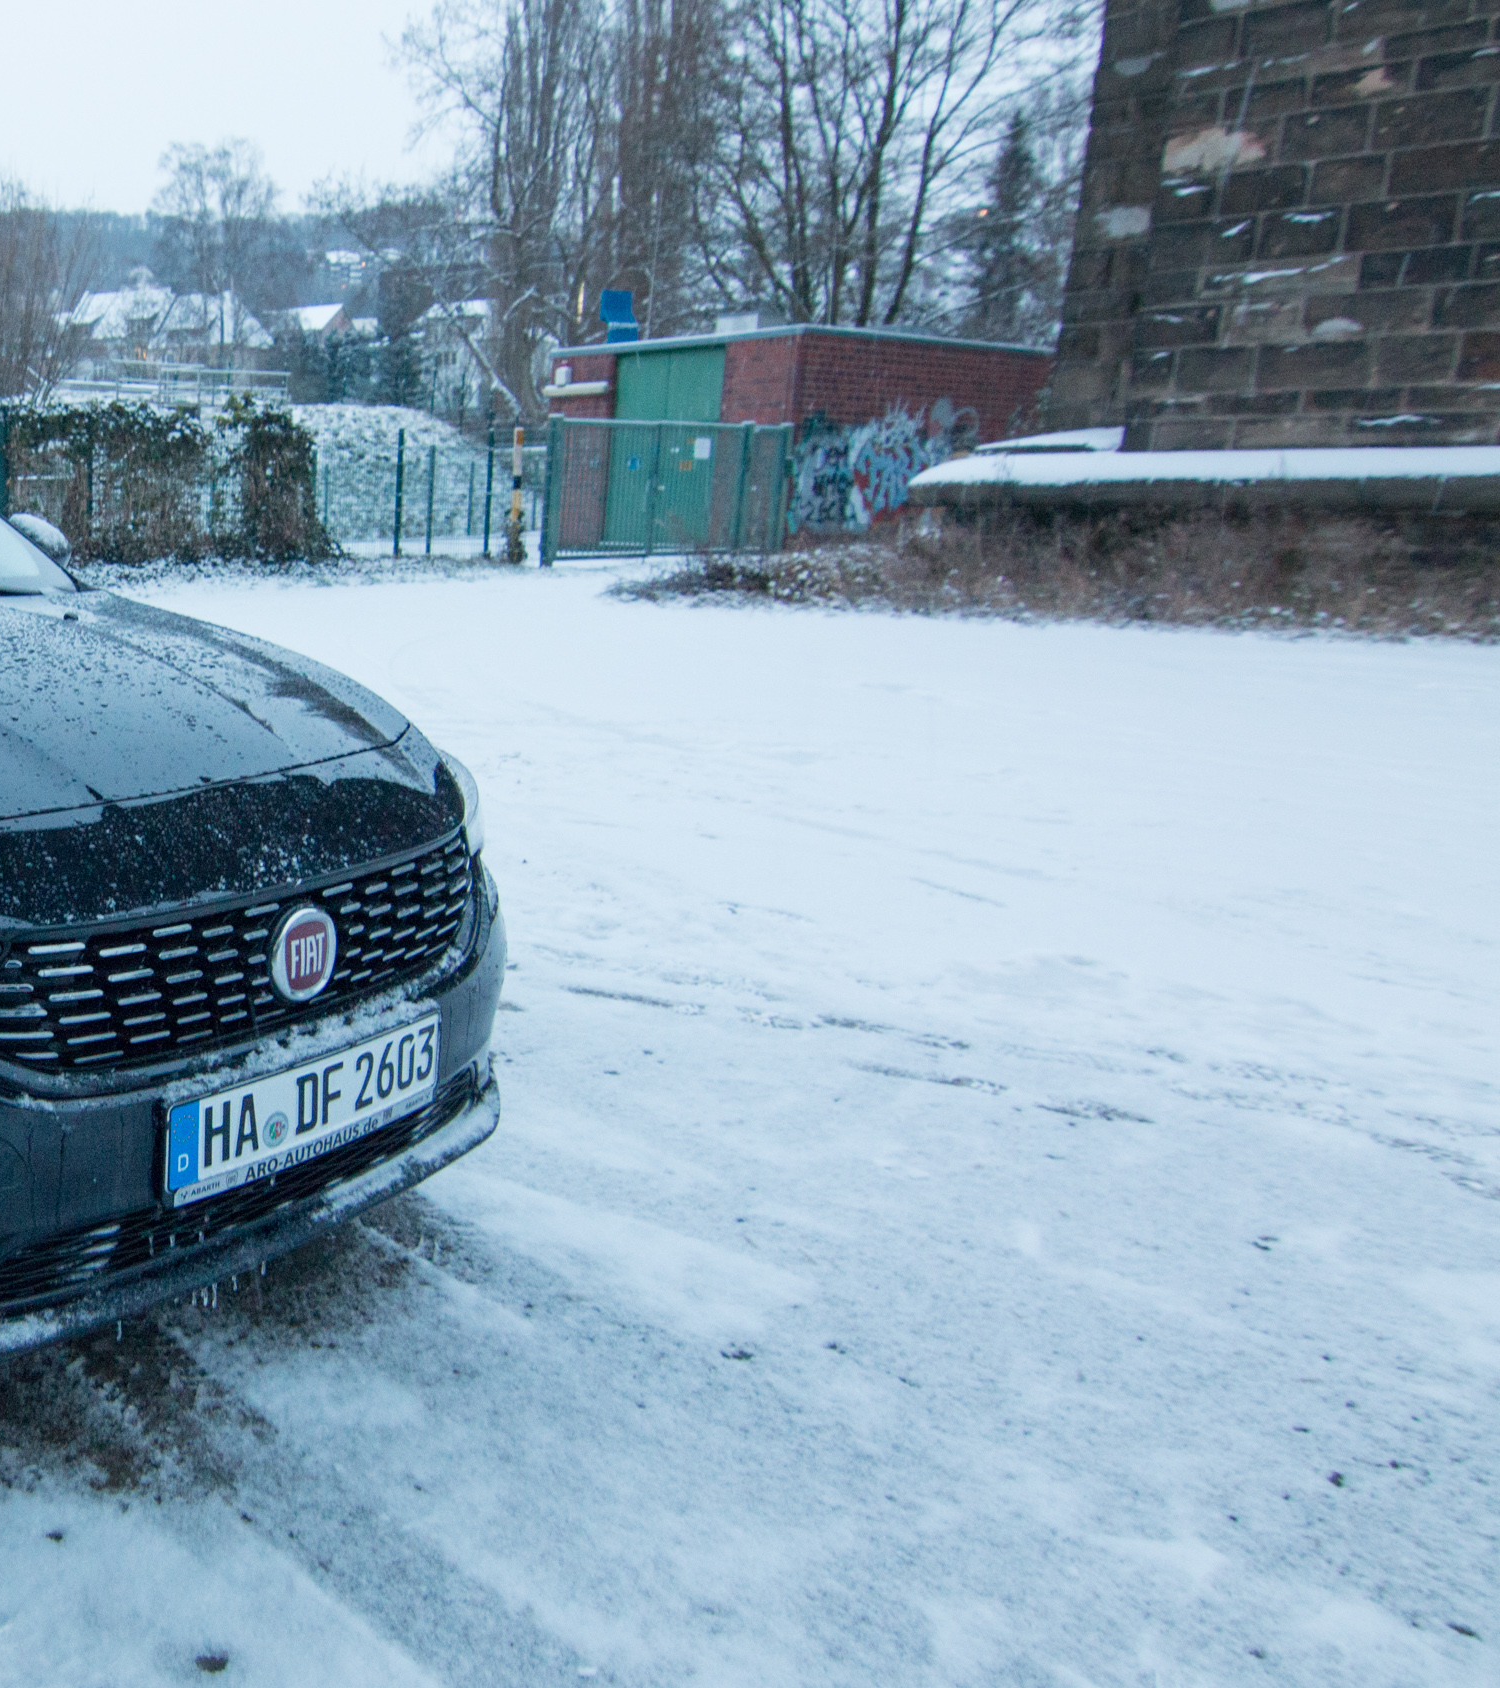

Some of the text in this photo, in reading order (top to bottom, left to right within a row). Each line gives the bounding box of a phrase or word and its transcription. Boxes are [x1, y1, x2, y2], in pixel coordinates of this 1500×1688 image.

[290, 932, 325, 980] FIAT
[203, 1024, 436, 1168] HA DF 2603
[177, 1153, 190, 1173] D
[190, 1180, 221, 1198] ABARTH
[244, 1116, 378, 1183] ARO-AUTOHAUS.de
